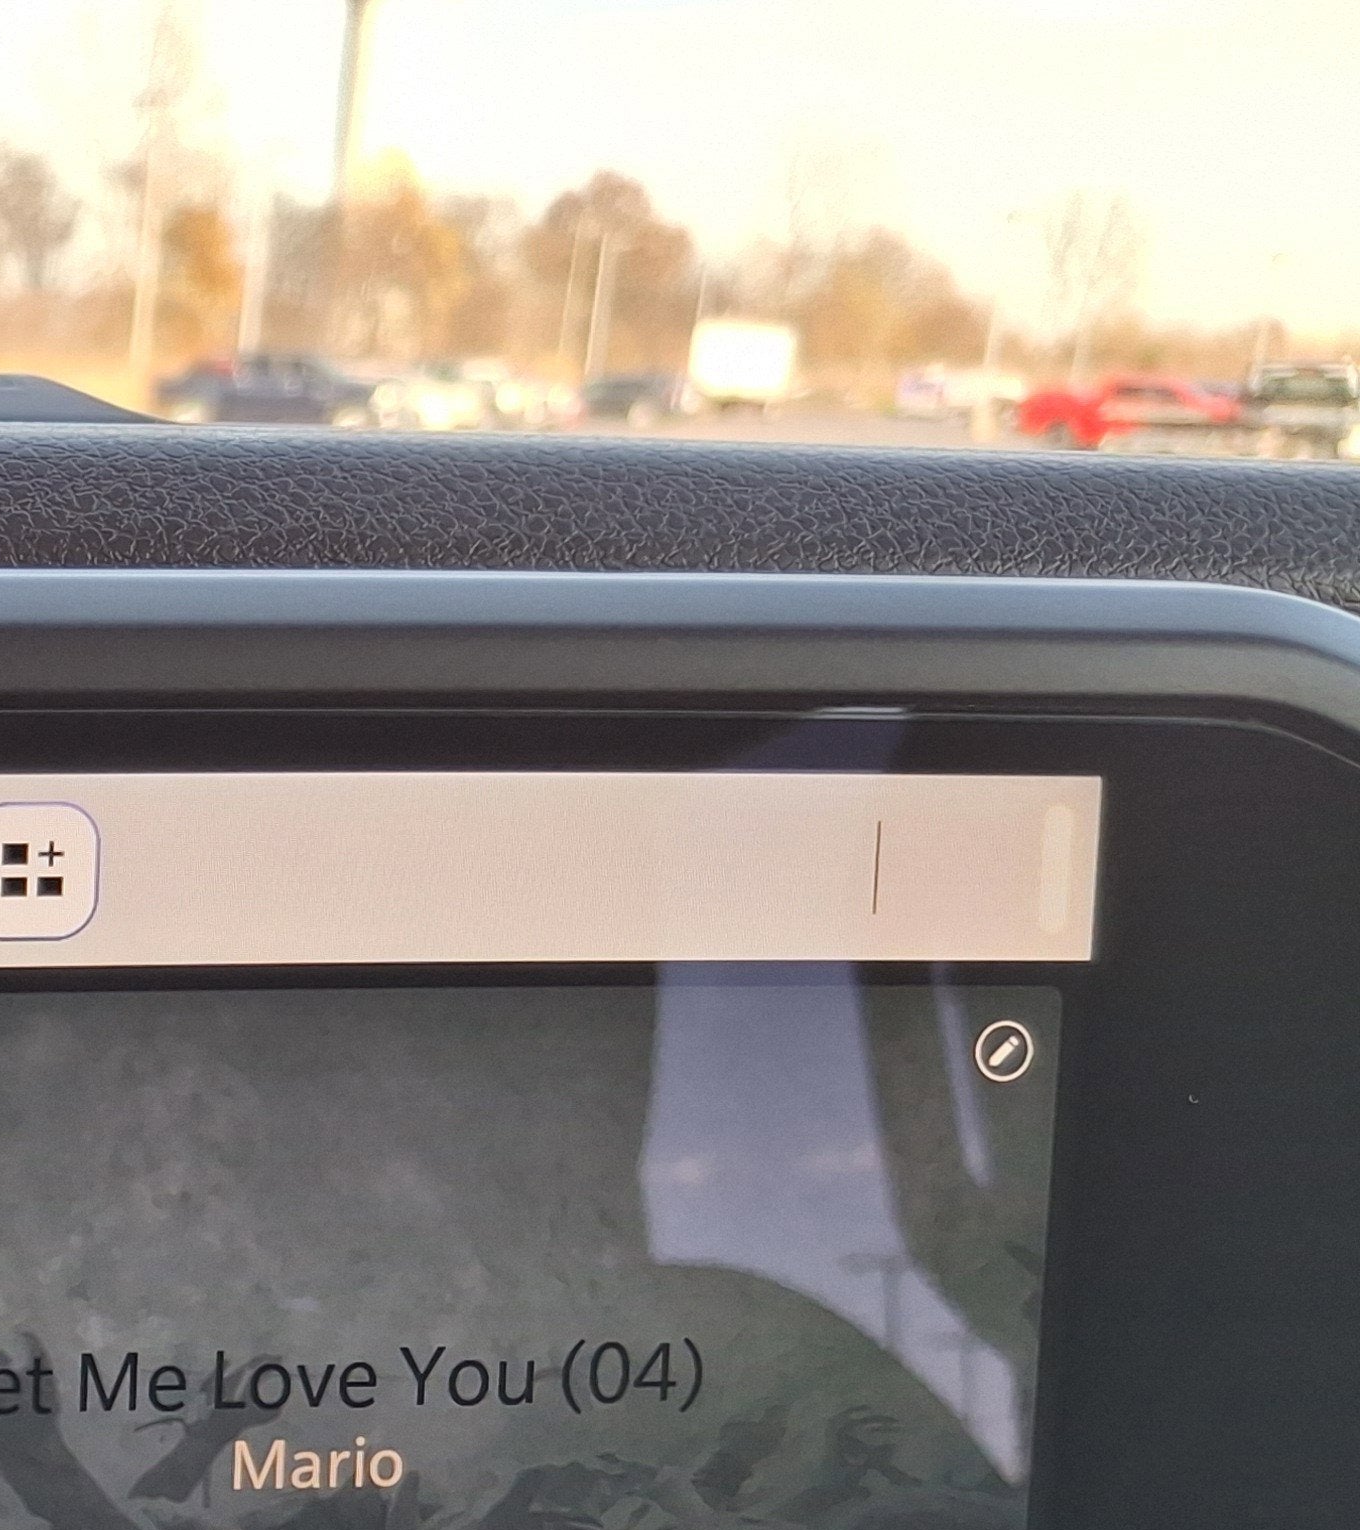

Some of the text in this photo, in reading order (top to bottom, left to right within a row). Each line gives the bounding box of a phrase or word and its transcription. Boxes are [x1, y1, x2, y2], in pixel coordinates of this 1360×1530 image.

[78, 1352, 188, 1412] Me
[212, 1350, 378, 1410] Love
[398, 1346, 536, 1407] You
[560, 1337, 704, 1415] (04)
[231, 1437, 404, 1491] Mario
